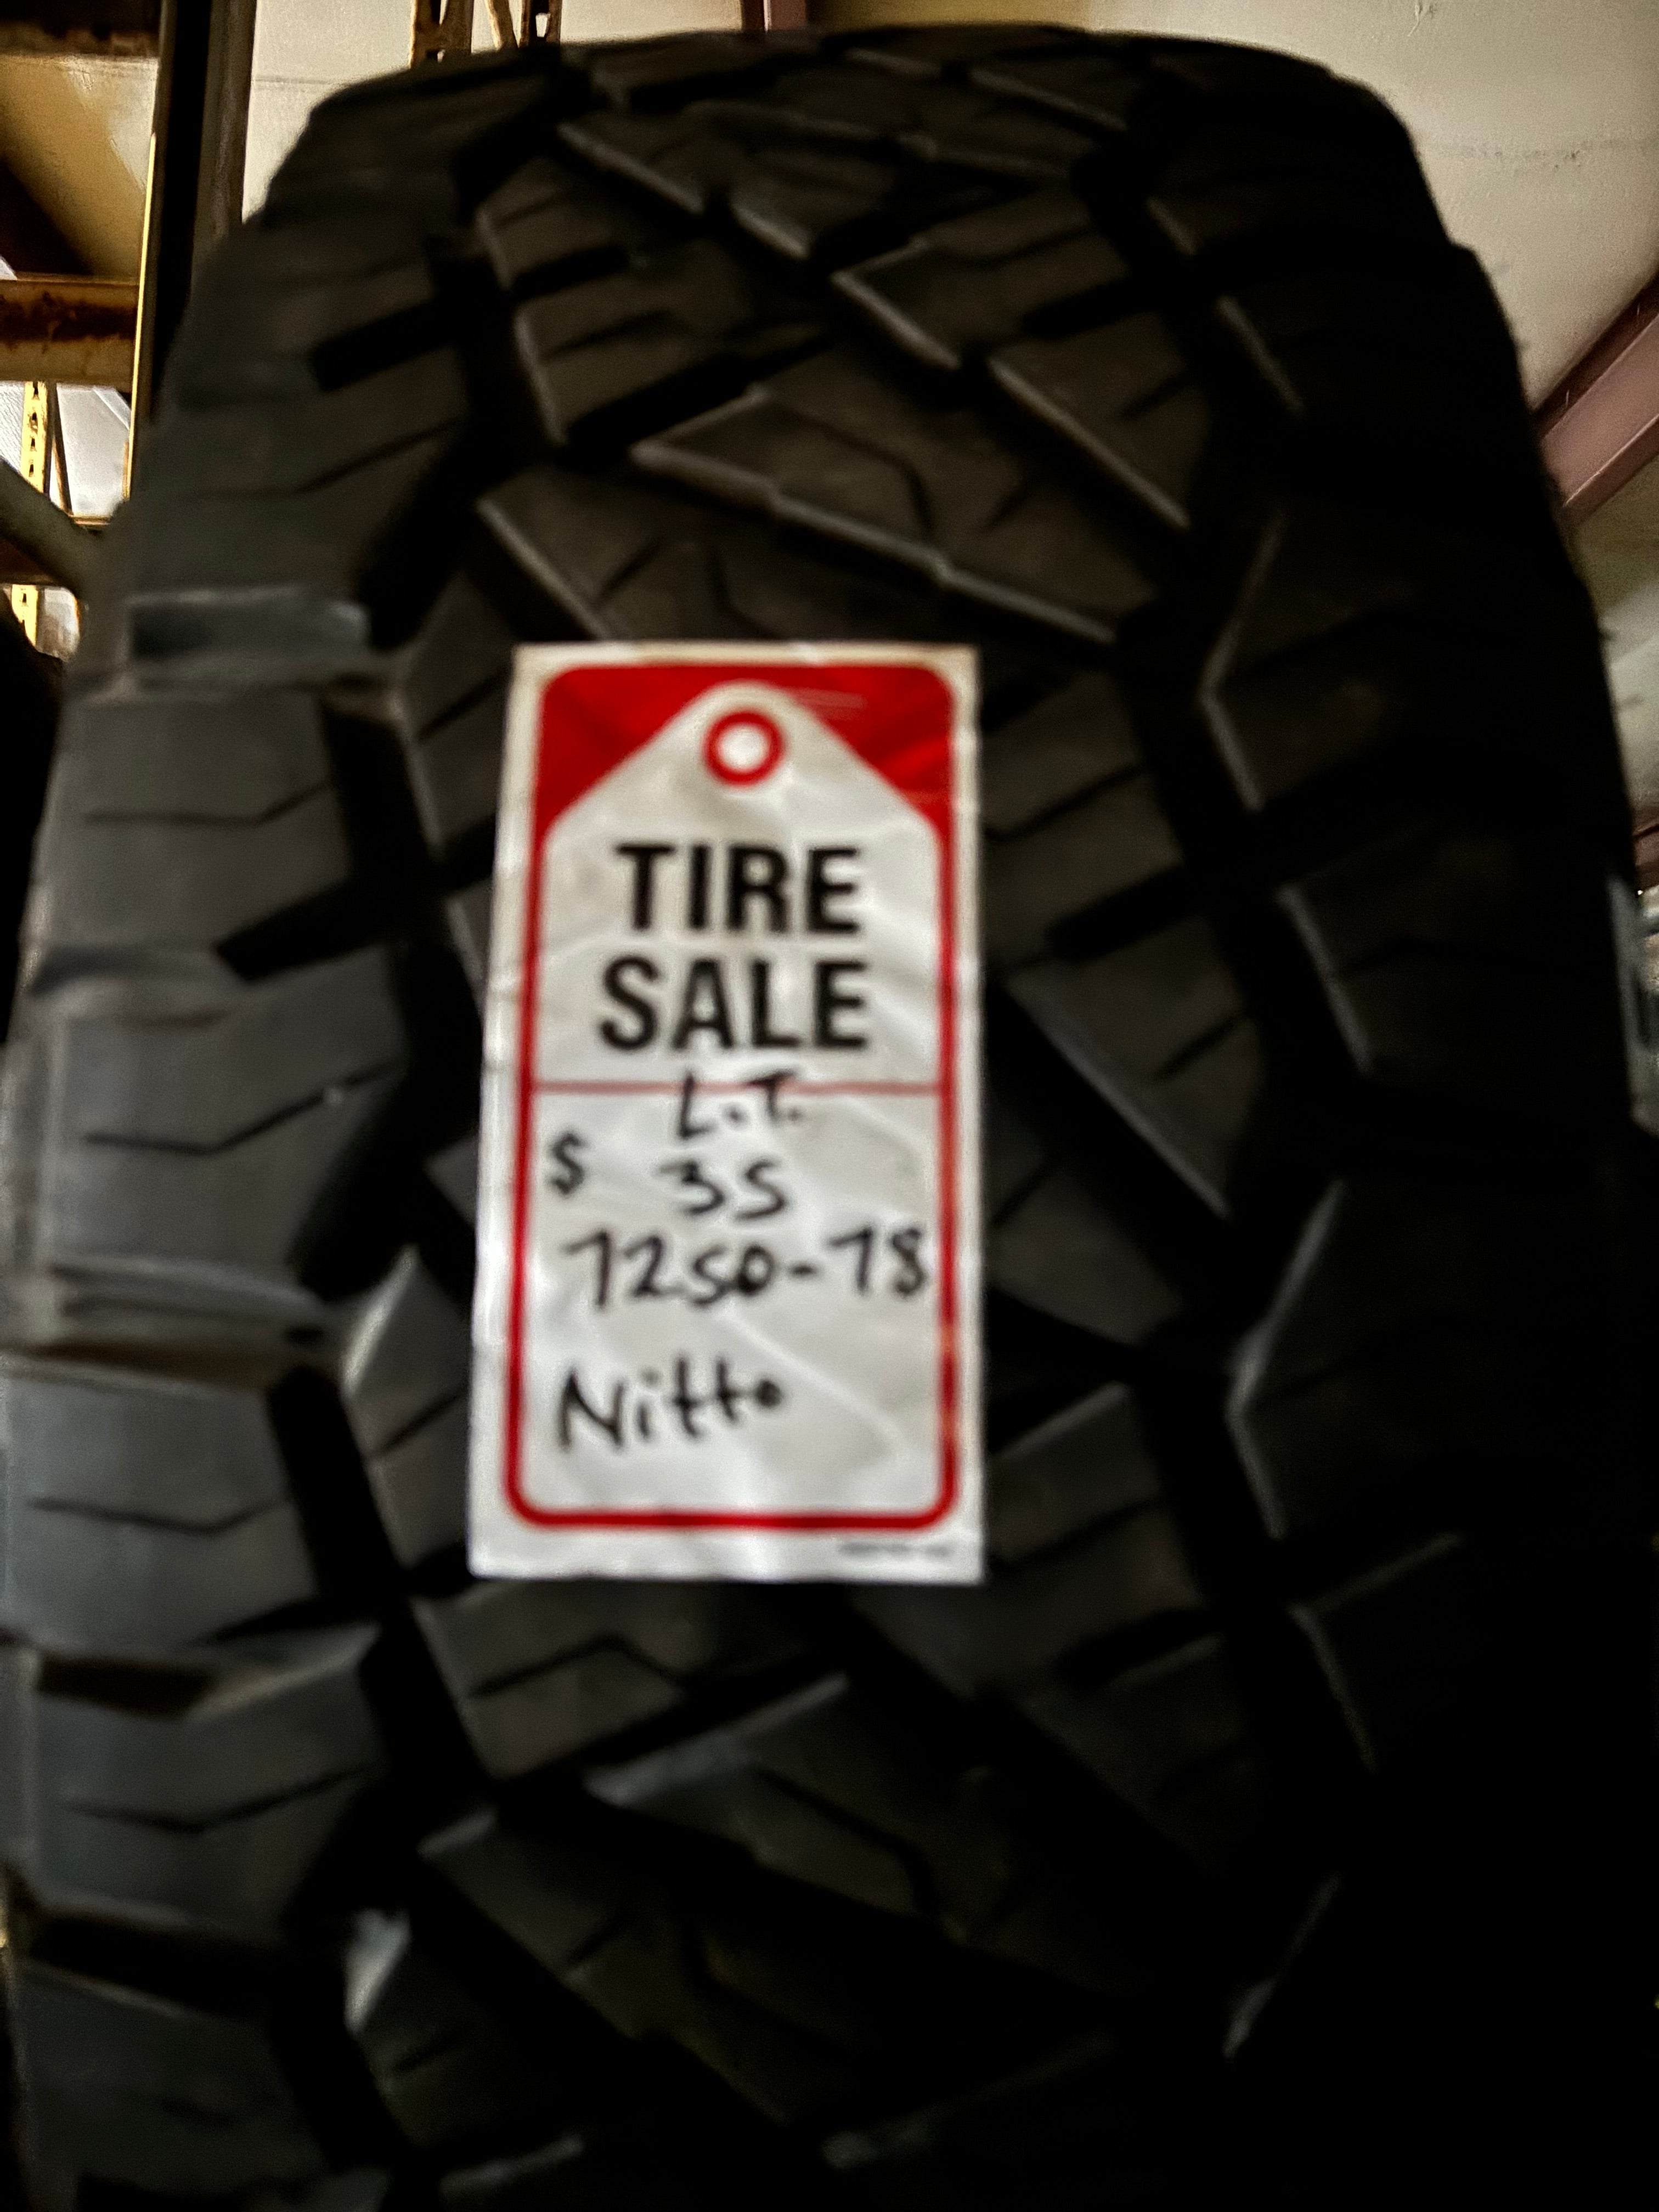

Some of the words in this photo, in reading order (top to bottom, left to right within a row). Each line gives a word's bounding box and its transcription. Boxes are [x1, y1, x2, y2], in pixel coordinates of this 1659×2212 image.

[613, 842, 861, 935] TIRE
[598, 956, 869, 1052] SALE
[549, 1132, 586, 1196] $
[658, 1158, 789, 1220] 35
[555, 1358, 782, 1454] Nitto
